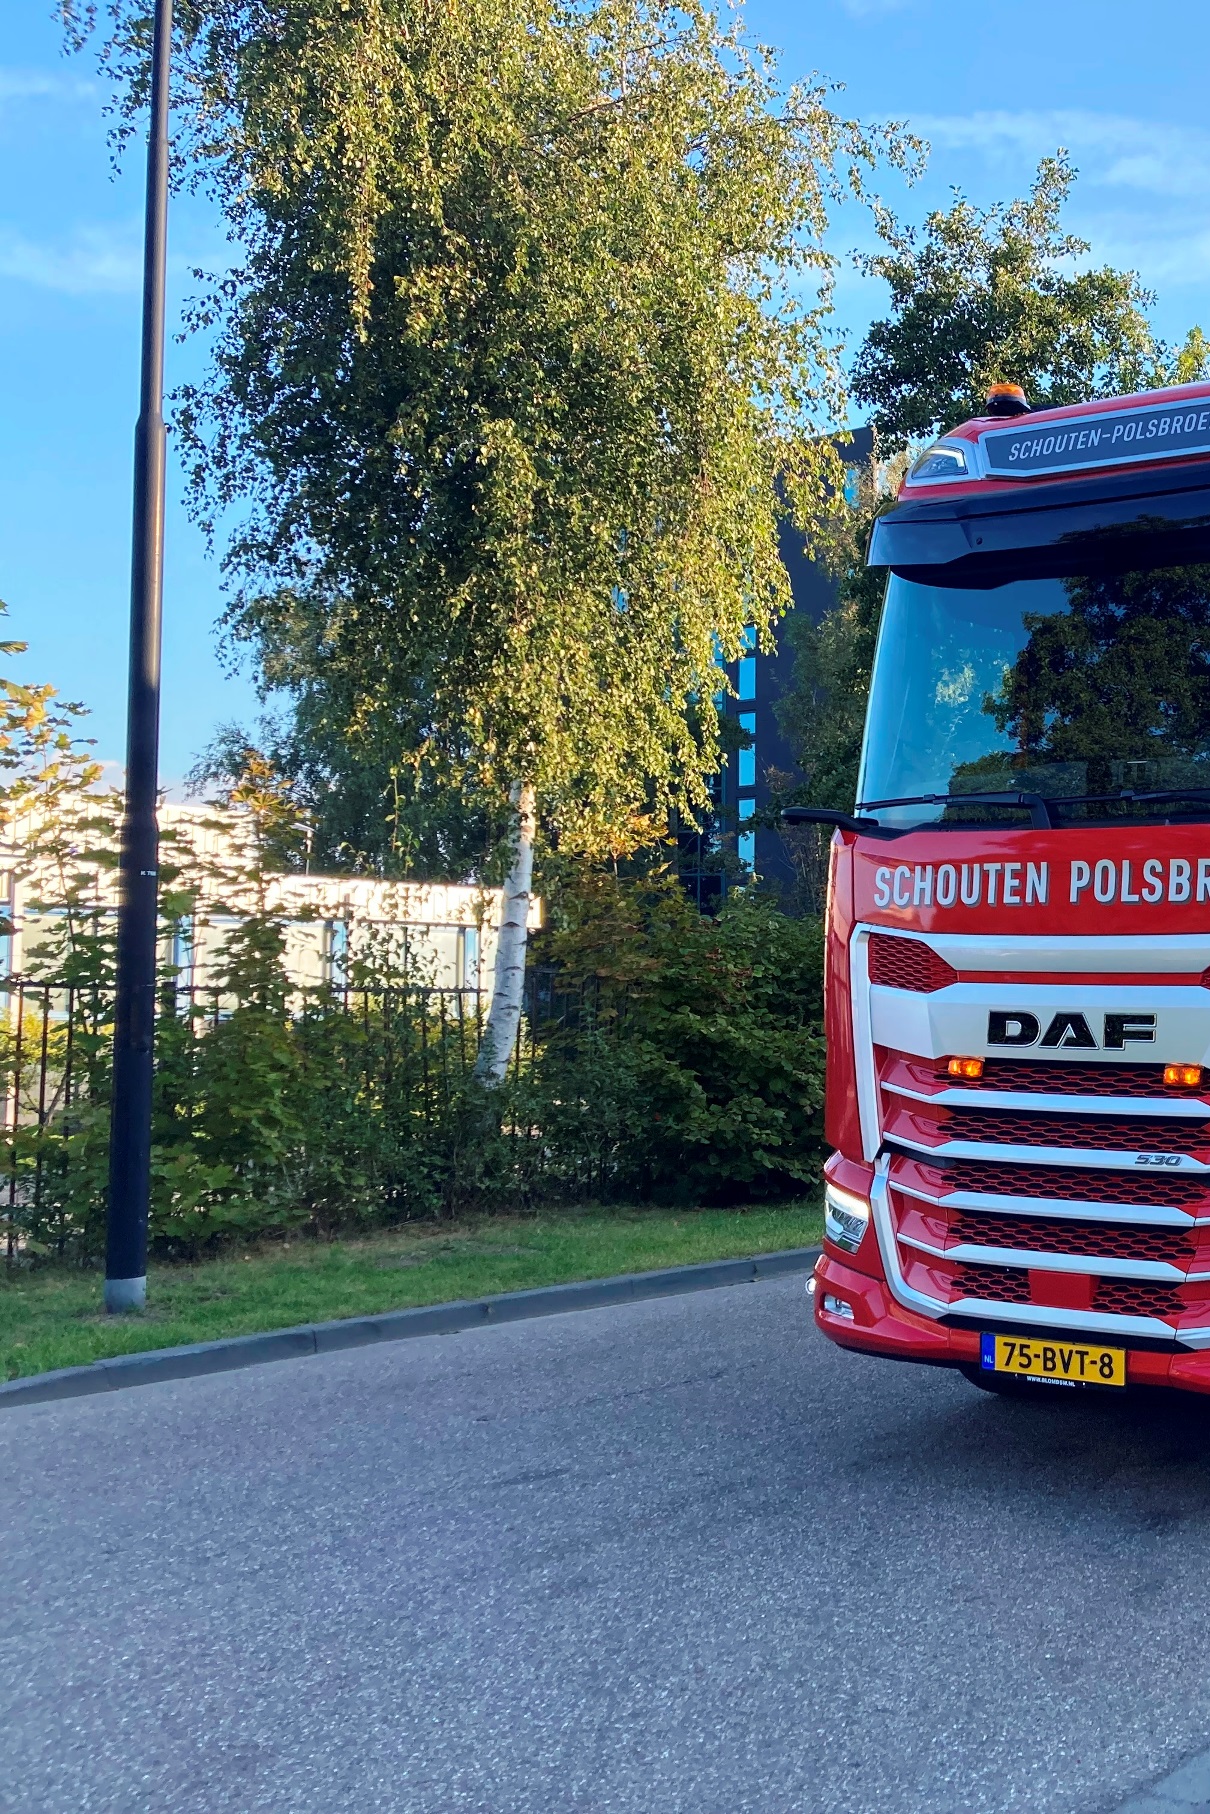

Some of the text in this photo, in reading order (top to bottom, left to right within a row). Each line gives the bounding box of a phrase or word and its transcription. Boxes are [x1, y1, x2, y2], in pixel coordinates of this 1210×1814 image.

[874, 861, 1050, 907] SCHOUTEN
[987, 1009, 1157, 1051] DAF
[1134, 1154, 1182, 1167] 530
[984, 1341, 1114, 1379] NL 75-BVT-8
